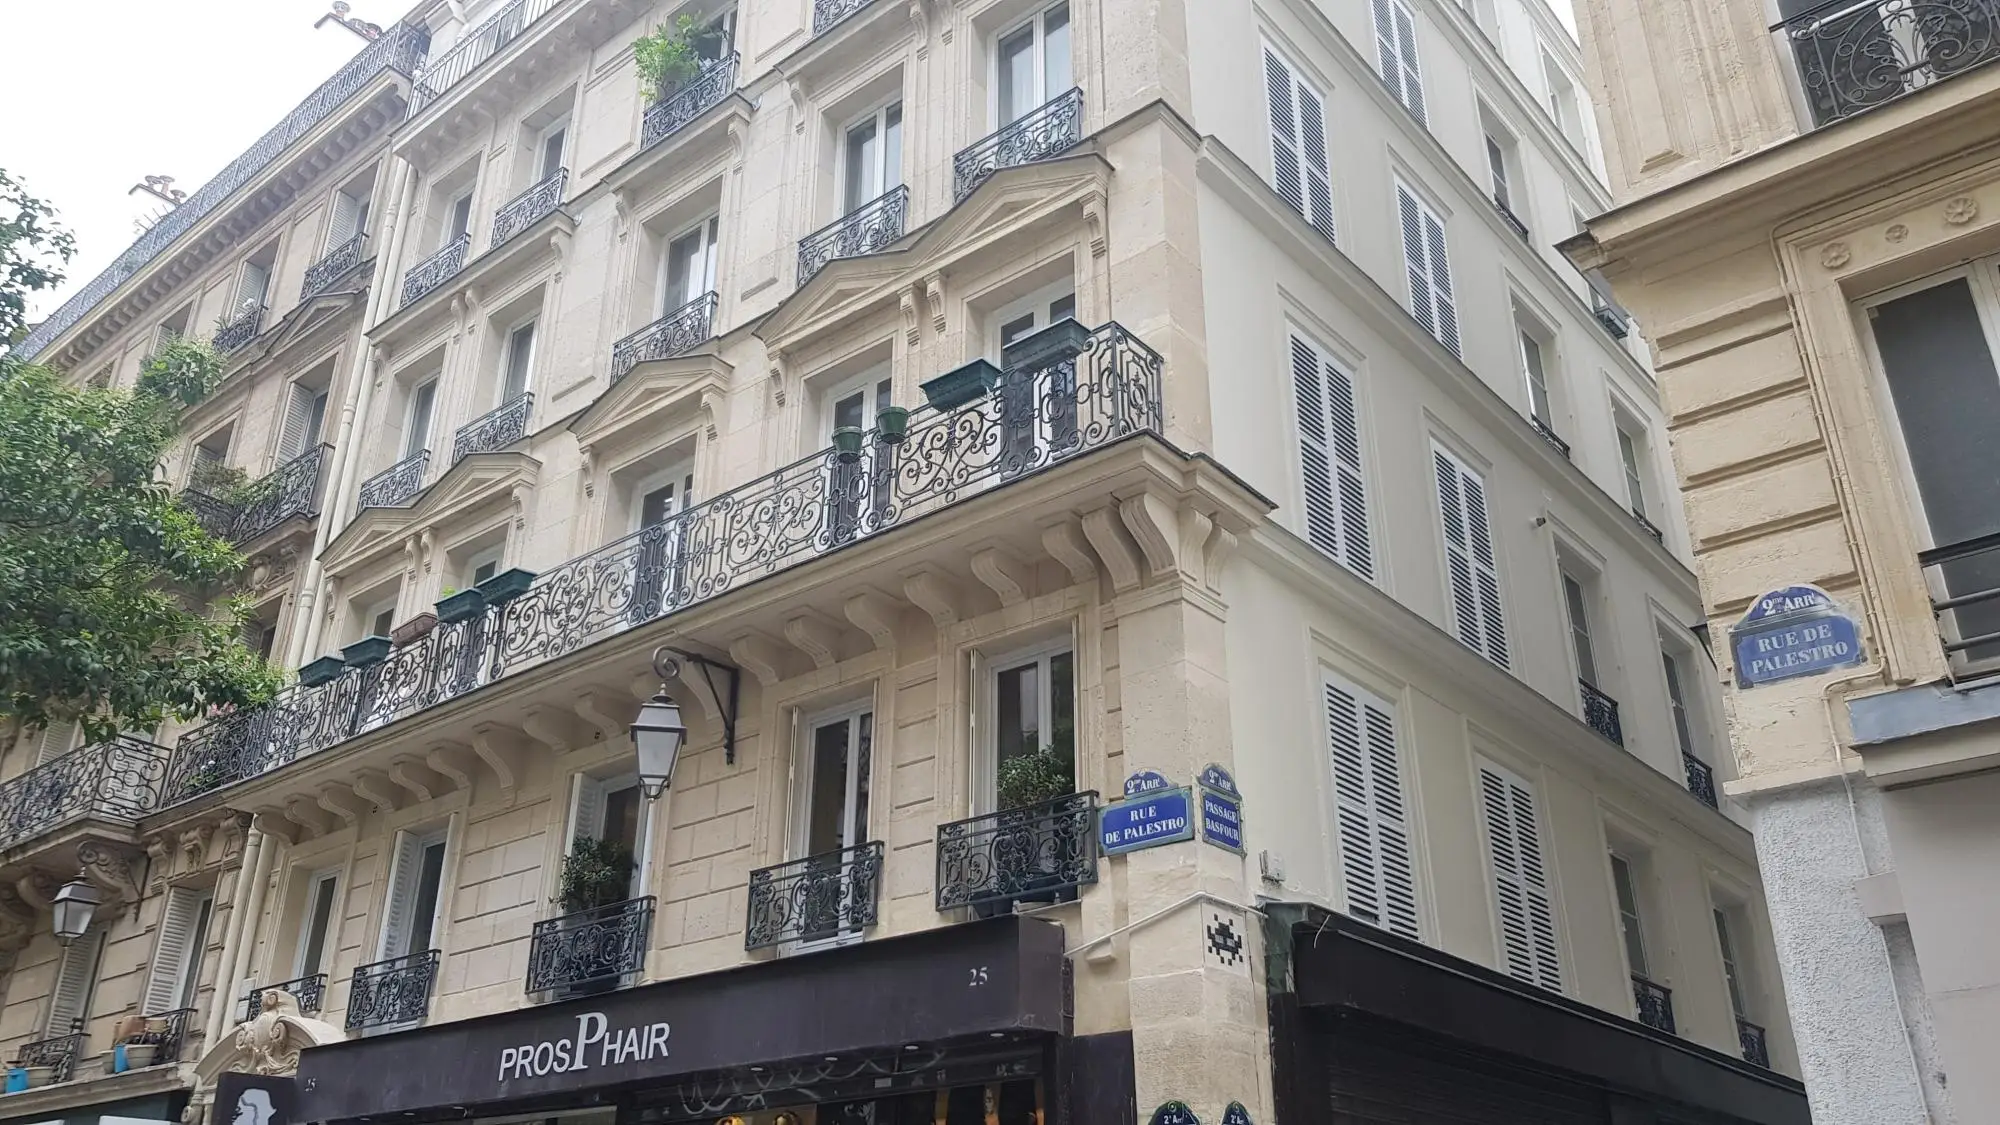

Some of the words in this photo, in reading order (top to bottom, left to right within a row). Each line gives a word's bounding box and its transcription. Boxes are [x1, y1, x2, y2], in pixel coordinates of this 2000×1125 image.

[1758, 631, 1799, 653] RUE
[1803, 624, 1832, 643] DE
[1752, 641, 1849, 674] PALESTRO
[1130, 806, 1157, 821] RUE
[1205, 799, 1237, 824] PASSAGE
[1105, 830, 1121, 844] DE
[1124, 816, 1184, 840] PALESTRO
[1205, 817, 1239, 841] BASFOUR
[969, 966, 988, 987] 25
